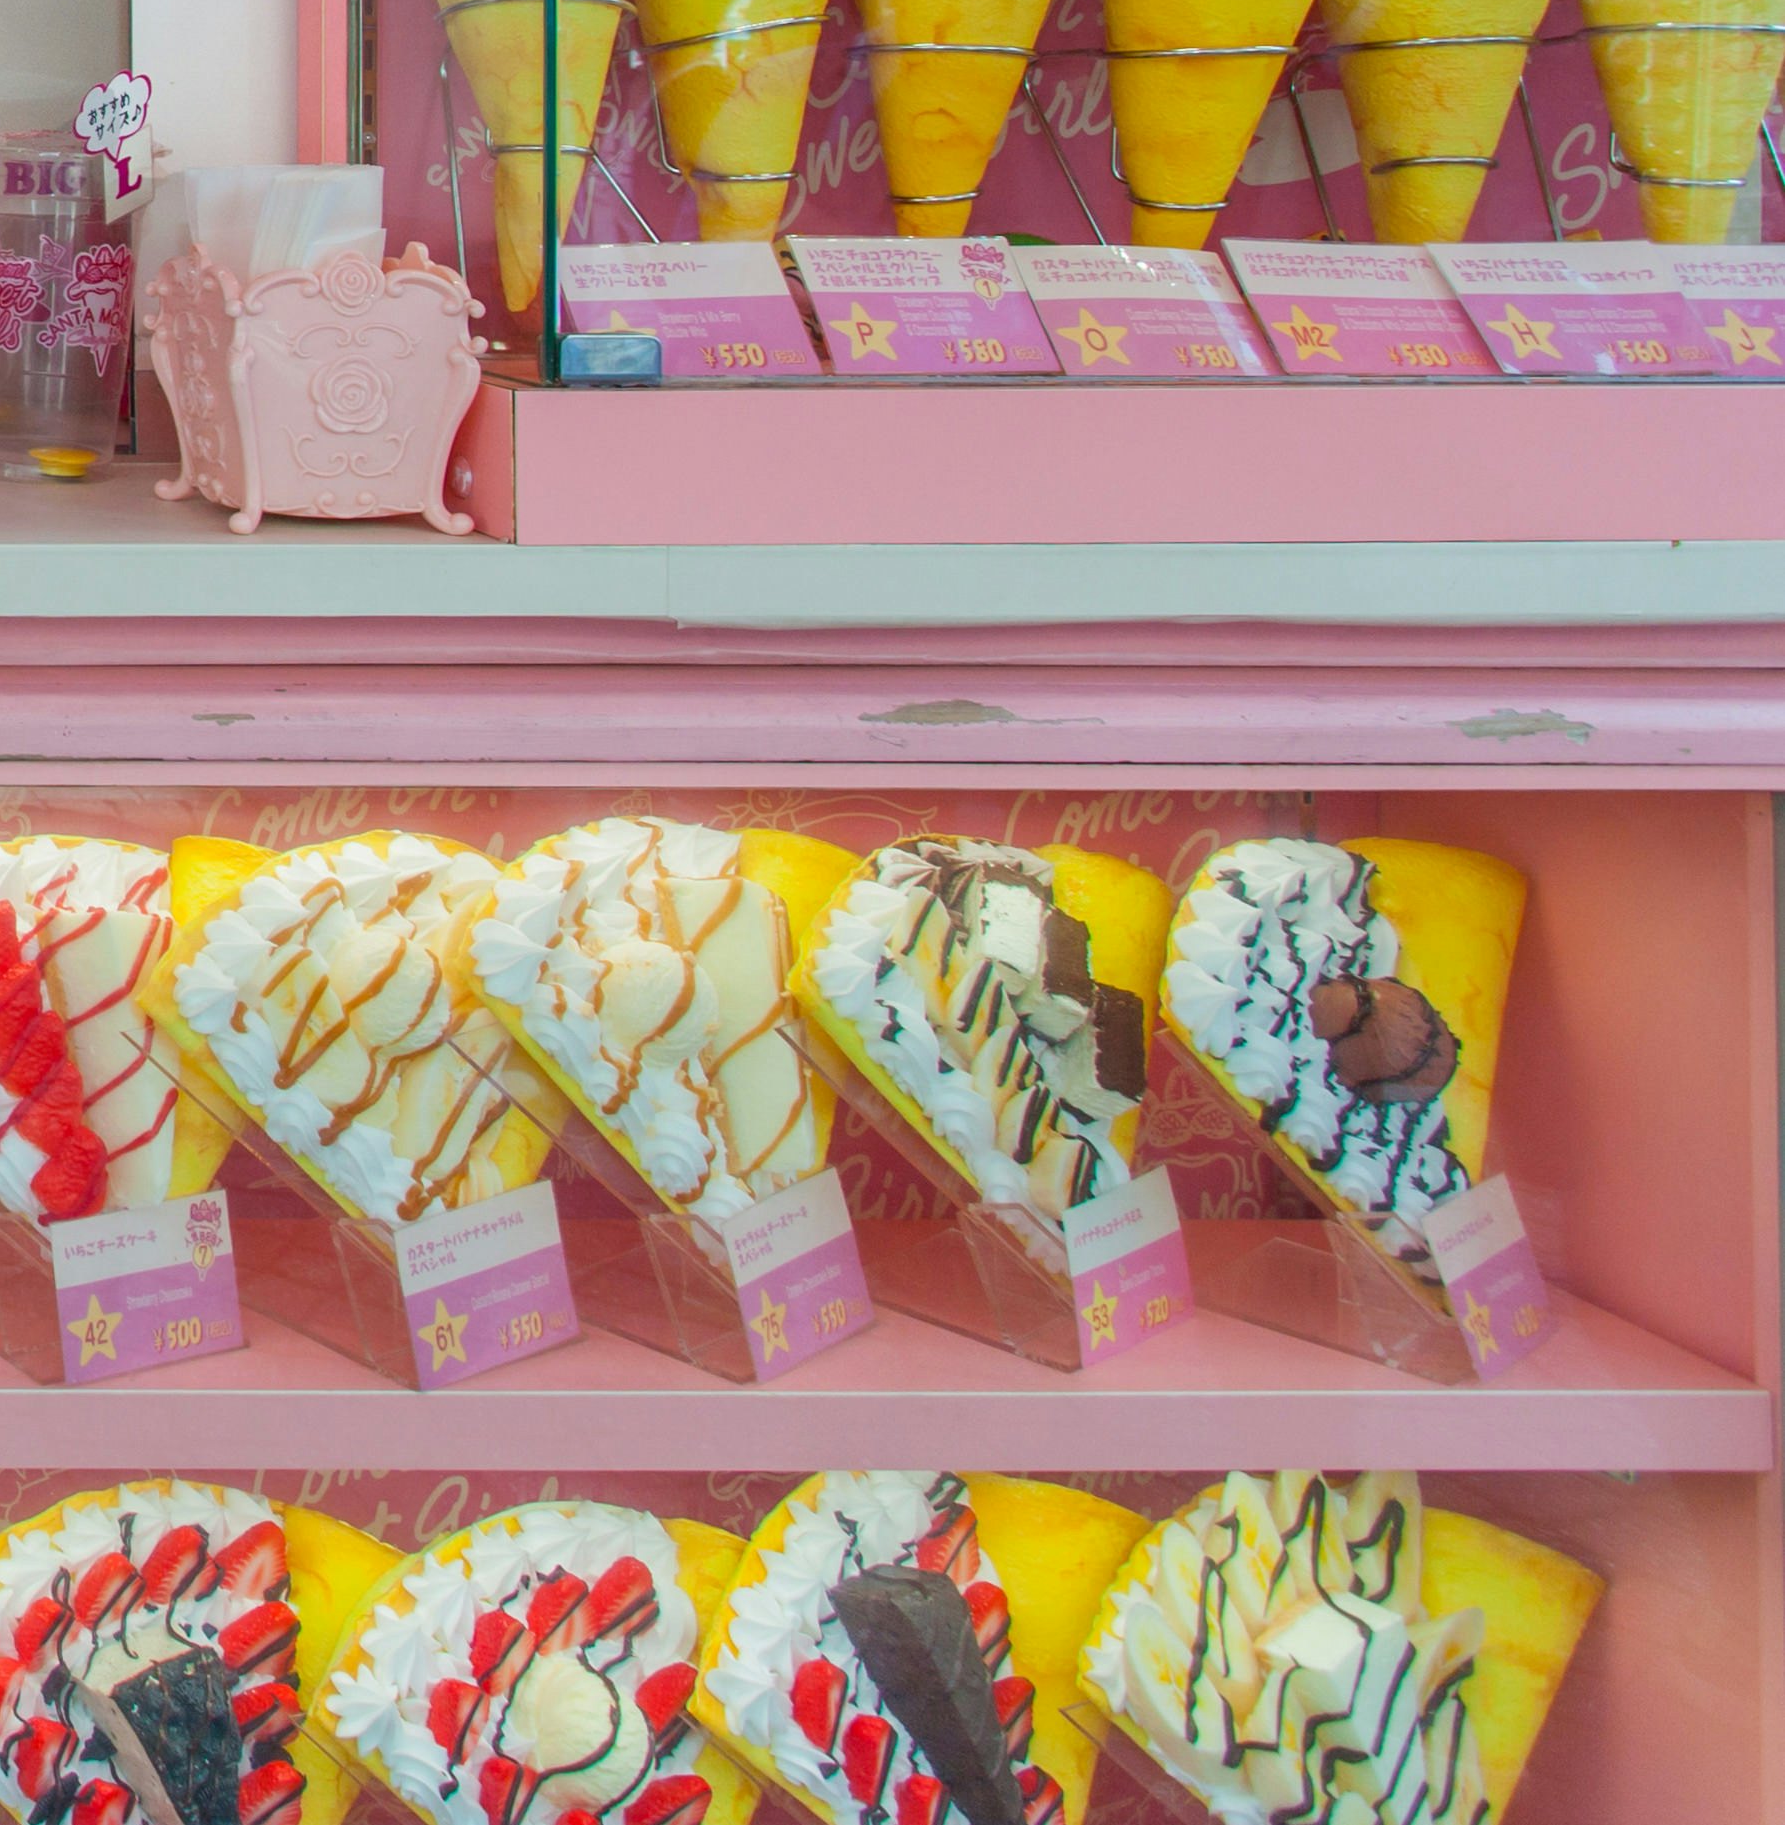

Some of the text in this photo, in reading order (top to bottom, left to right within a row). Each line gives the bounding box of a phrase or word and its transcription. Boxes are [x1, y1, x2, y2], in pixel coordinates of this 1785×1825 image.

[88, 93, 131, 125] おすすめ
[115, 156, 142, 200] L
[857, 322, 873, 346] P
[1293, 326, 1331, 348] M2
[698, 343, 766, 368] ¥550
[941, 338, 1006, 364] ¥580
[1388, 343, 1449, 367] ¥580
[65, 1231, 157, 1260] いちごチーズケーキ
[409, 1253, 456, 1277] スペシャル
[499, 1312, 543, 1351] ¥550
[1092, 1304, 1110, 1332] 53
[85, 1319, 108, 1346] 42
[153, 1316, 202, 1354] ¥500
[436, 1323, 455, 1352] 61
